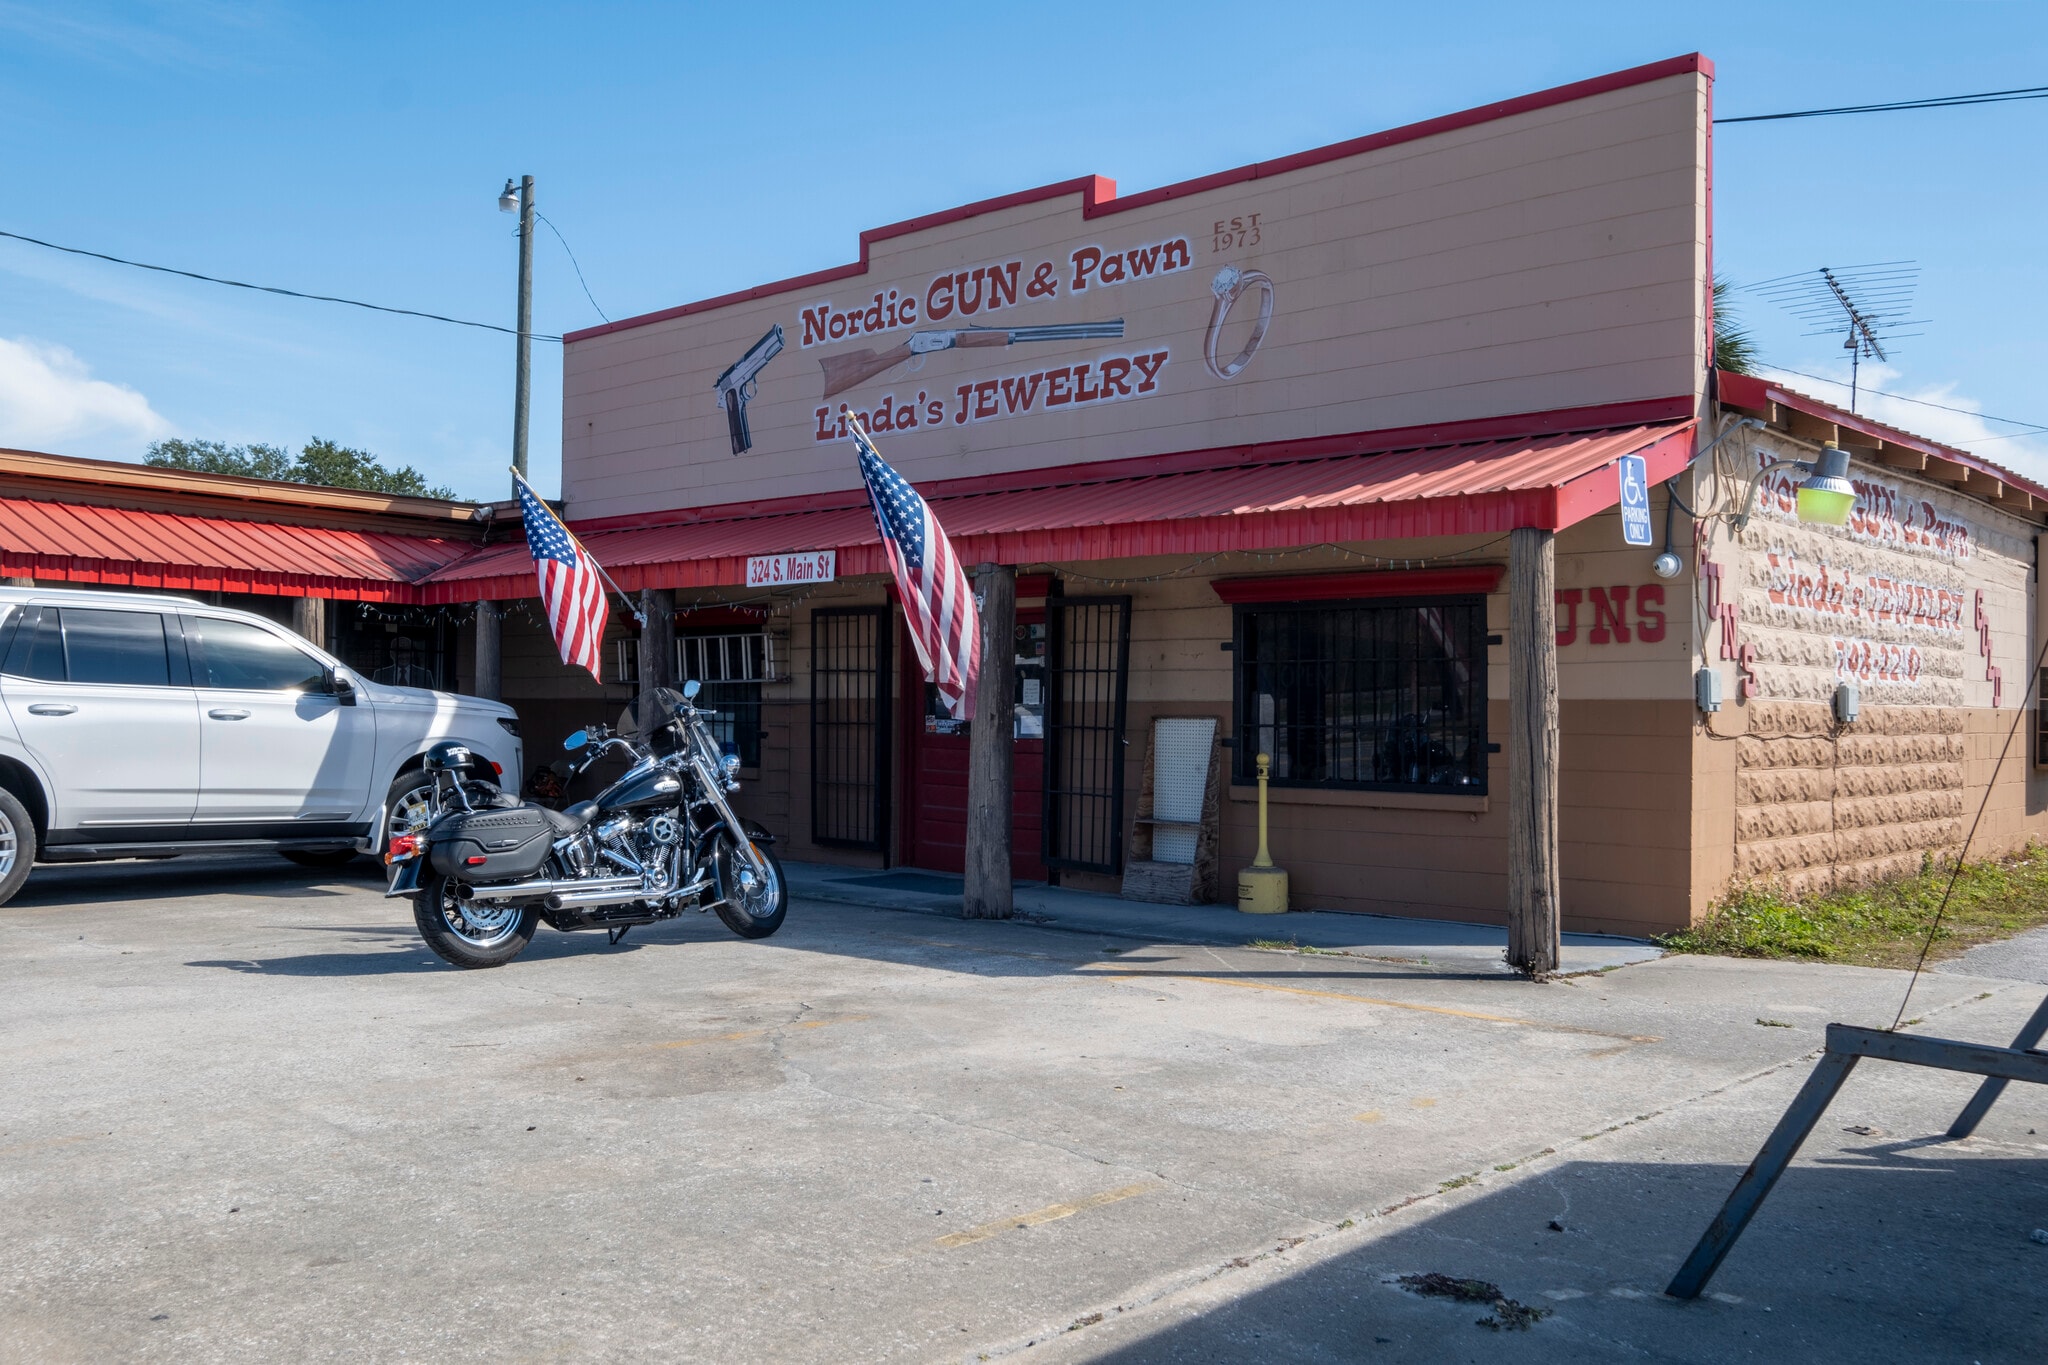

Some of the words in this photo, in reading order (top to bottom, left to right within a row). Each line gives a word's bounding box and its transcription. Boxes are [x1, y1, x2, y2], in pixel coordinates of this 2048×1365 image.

[1212, 227, 1261, 253] 1973
[802, 290, 916, 346] Nordic
[926, 261, 1021, 321] GUN
[1026, 261, 1058, 298] &
[1072, 238, 1190, 291] Pawn
[815, 391, 944, 441] Linda's
[956, 351, 1169, 424] JEWELRY
[1624, 506, 1648, 524] PARKING
[1629, 522, 1645, 540] ONLY
[1921, 501, 1968, 558] Pawn
[751, 559, 770, 583] 324
[773, 558, 783, 582] S.
[786, 556, 813, 581] Main
[817, 554, 830, 579] St
[1767, 552, 1864, 619] Linda's
[1868, 576, 1964, 631] JEWELRY
[1554, 583, 1666, 647] UNS
